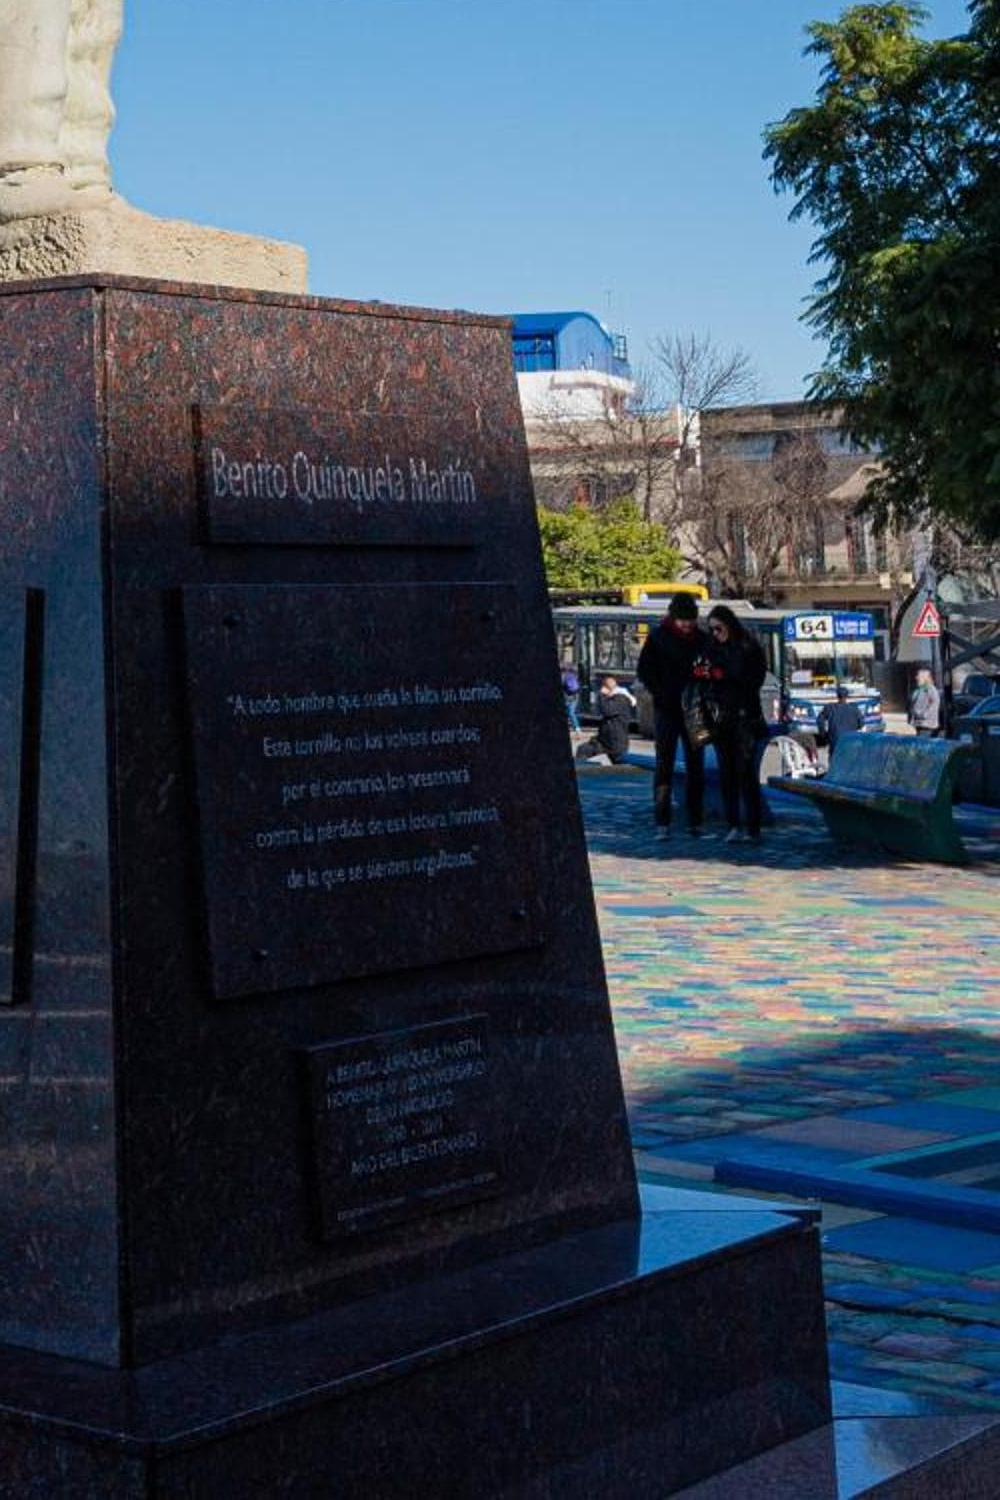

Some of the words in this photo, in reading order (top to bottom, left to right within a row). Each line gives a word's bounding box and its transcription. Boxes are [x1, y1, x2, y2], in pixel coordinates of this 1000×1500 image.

[212, 448, 287, 499] Benito
[293, 451, 405, 513] Quinquela
[409, 457, 477, 504] Martín
[801, 620, 827, 634] 64
[283, 691, 335, 713] hombre
[338, 694, 361, 716] que
[263, 736, 292, 757] Este
[295, 732, 341, 755] tornillo
[282, 784, 306, 804] por
[322, 869, 345, 891] que
